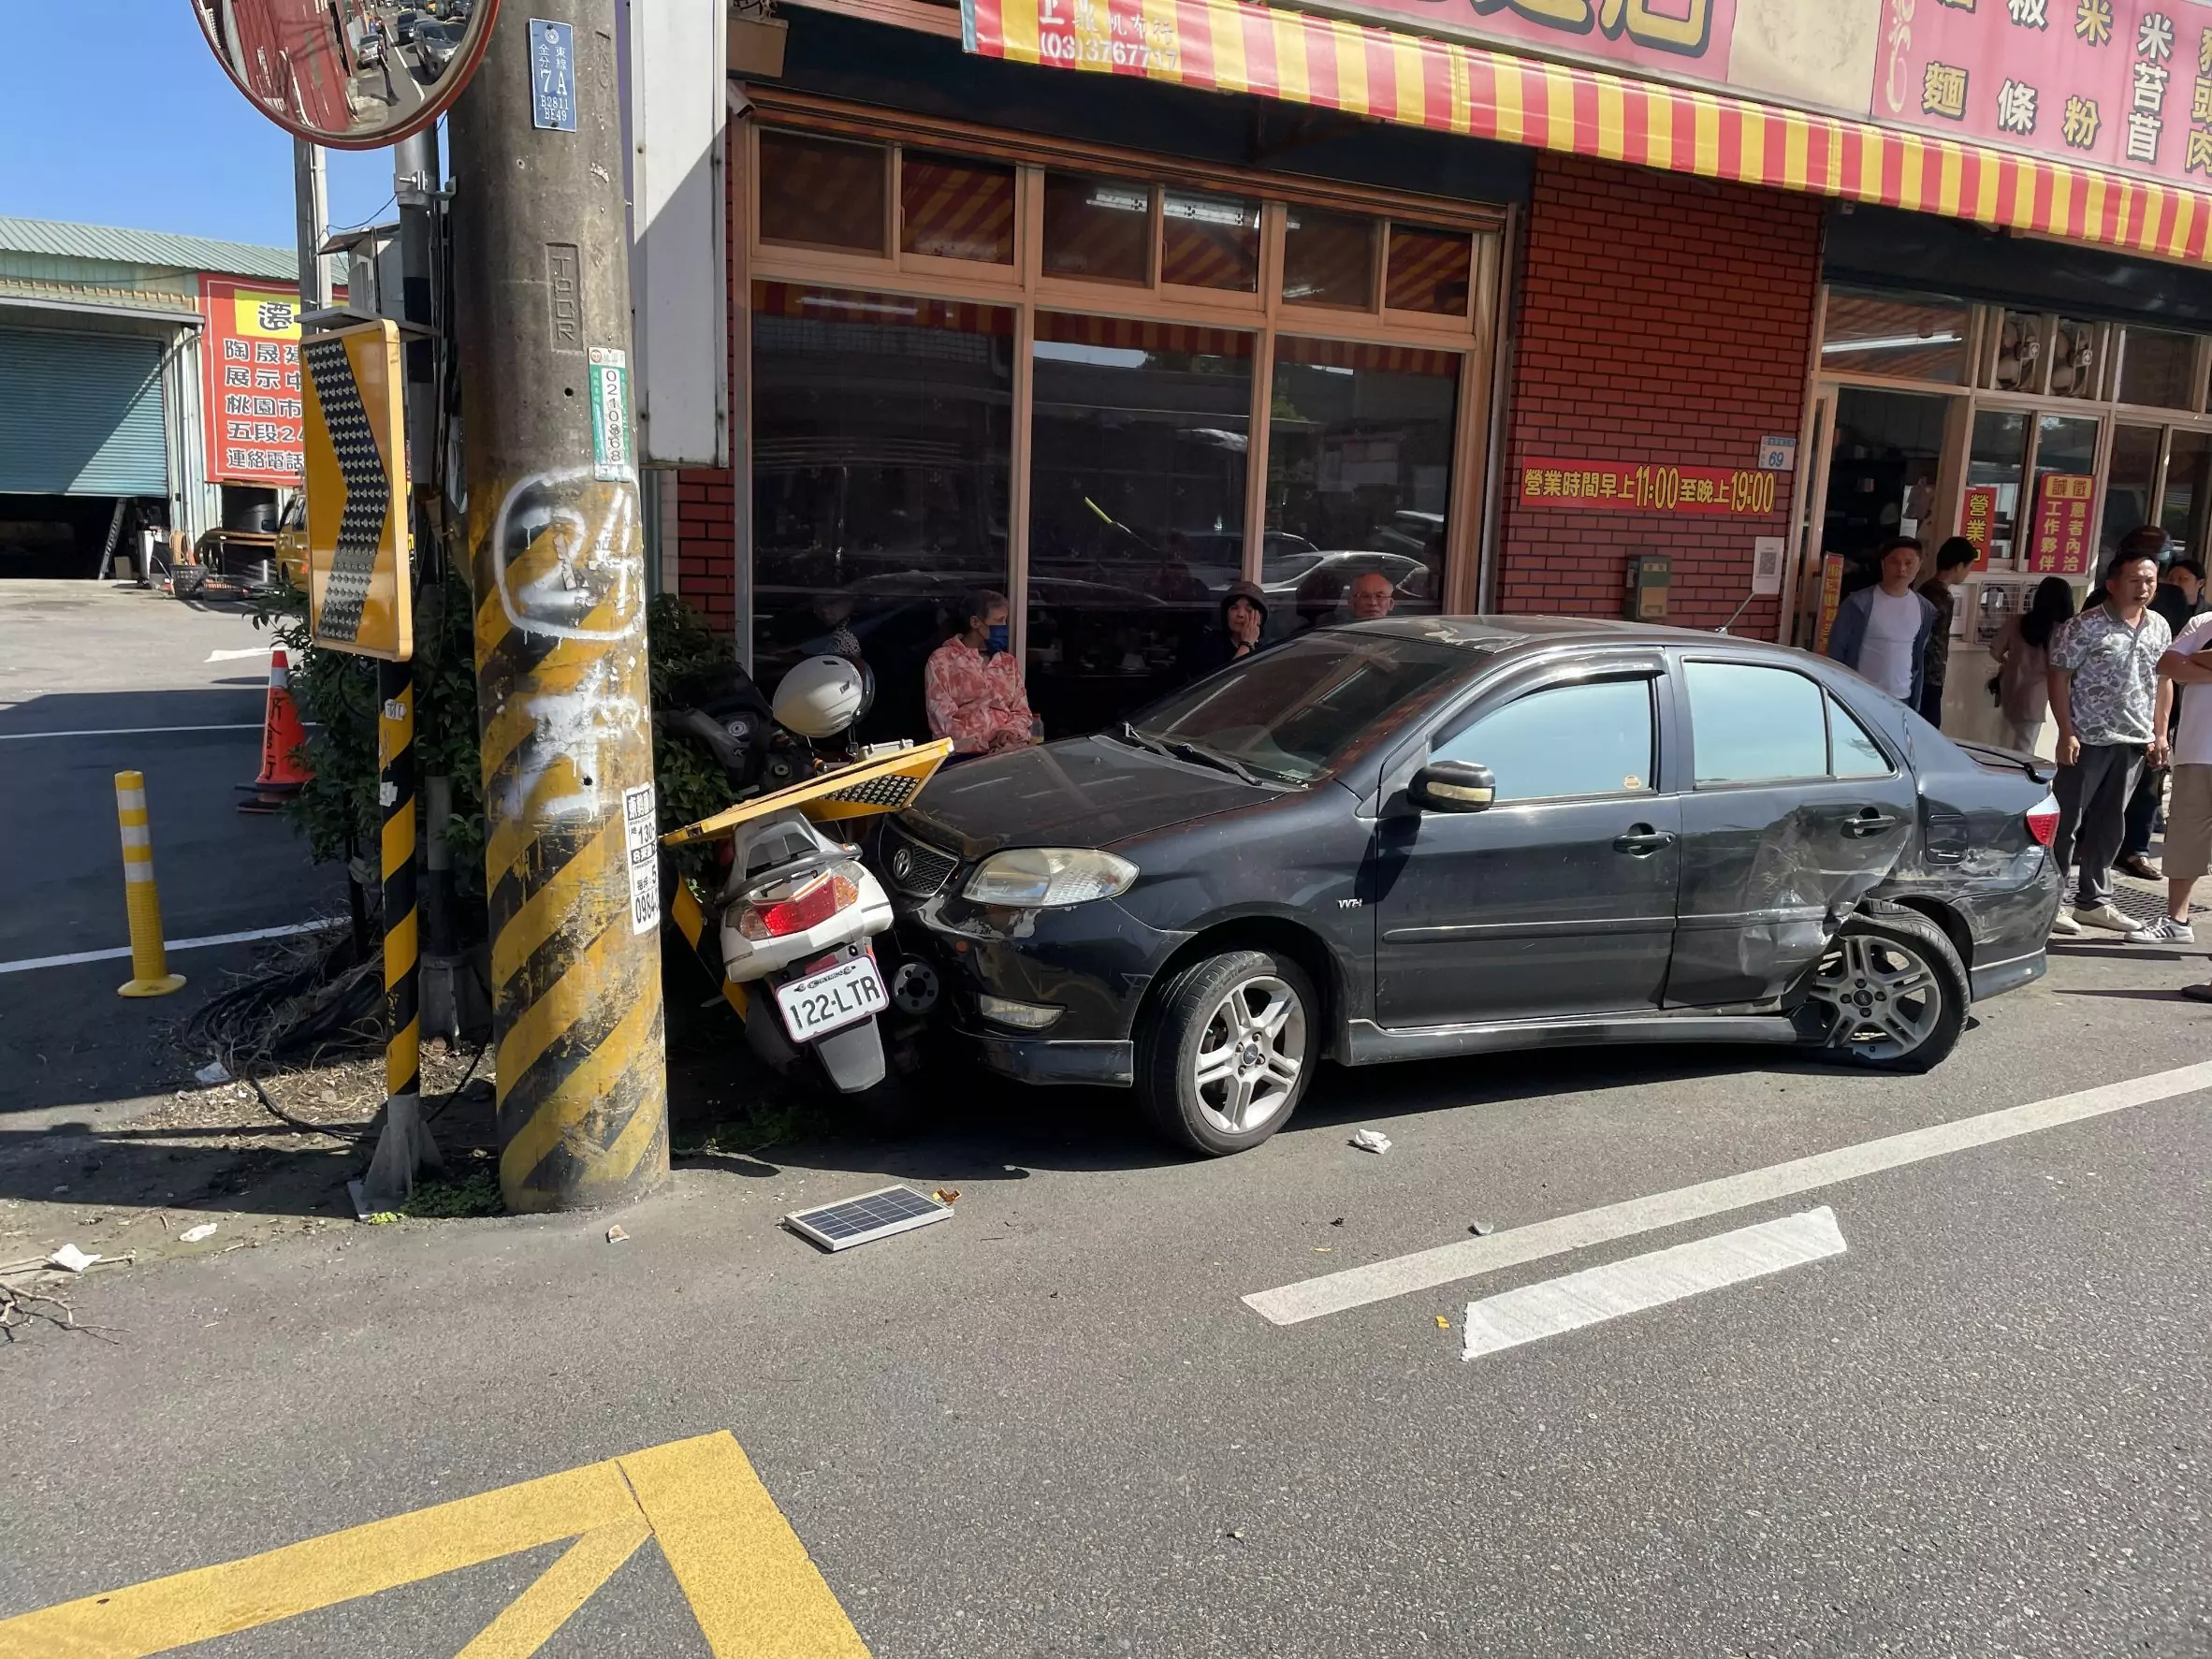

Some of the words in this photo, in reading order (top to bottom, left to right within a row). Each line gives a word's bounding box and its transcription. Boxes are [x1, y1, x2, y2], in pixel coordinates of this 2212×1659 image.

[258, 301, 293, 331] 遷
[226, 394, 302, 419] 桃園市
[226, 447, 304, 472] 連絡電話
[1768, 450, 1784, 467] 69
[2038, 501, 2063, 572] 工作夥伴
[789, 975, 880, 1031] 122-LTR
